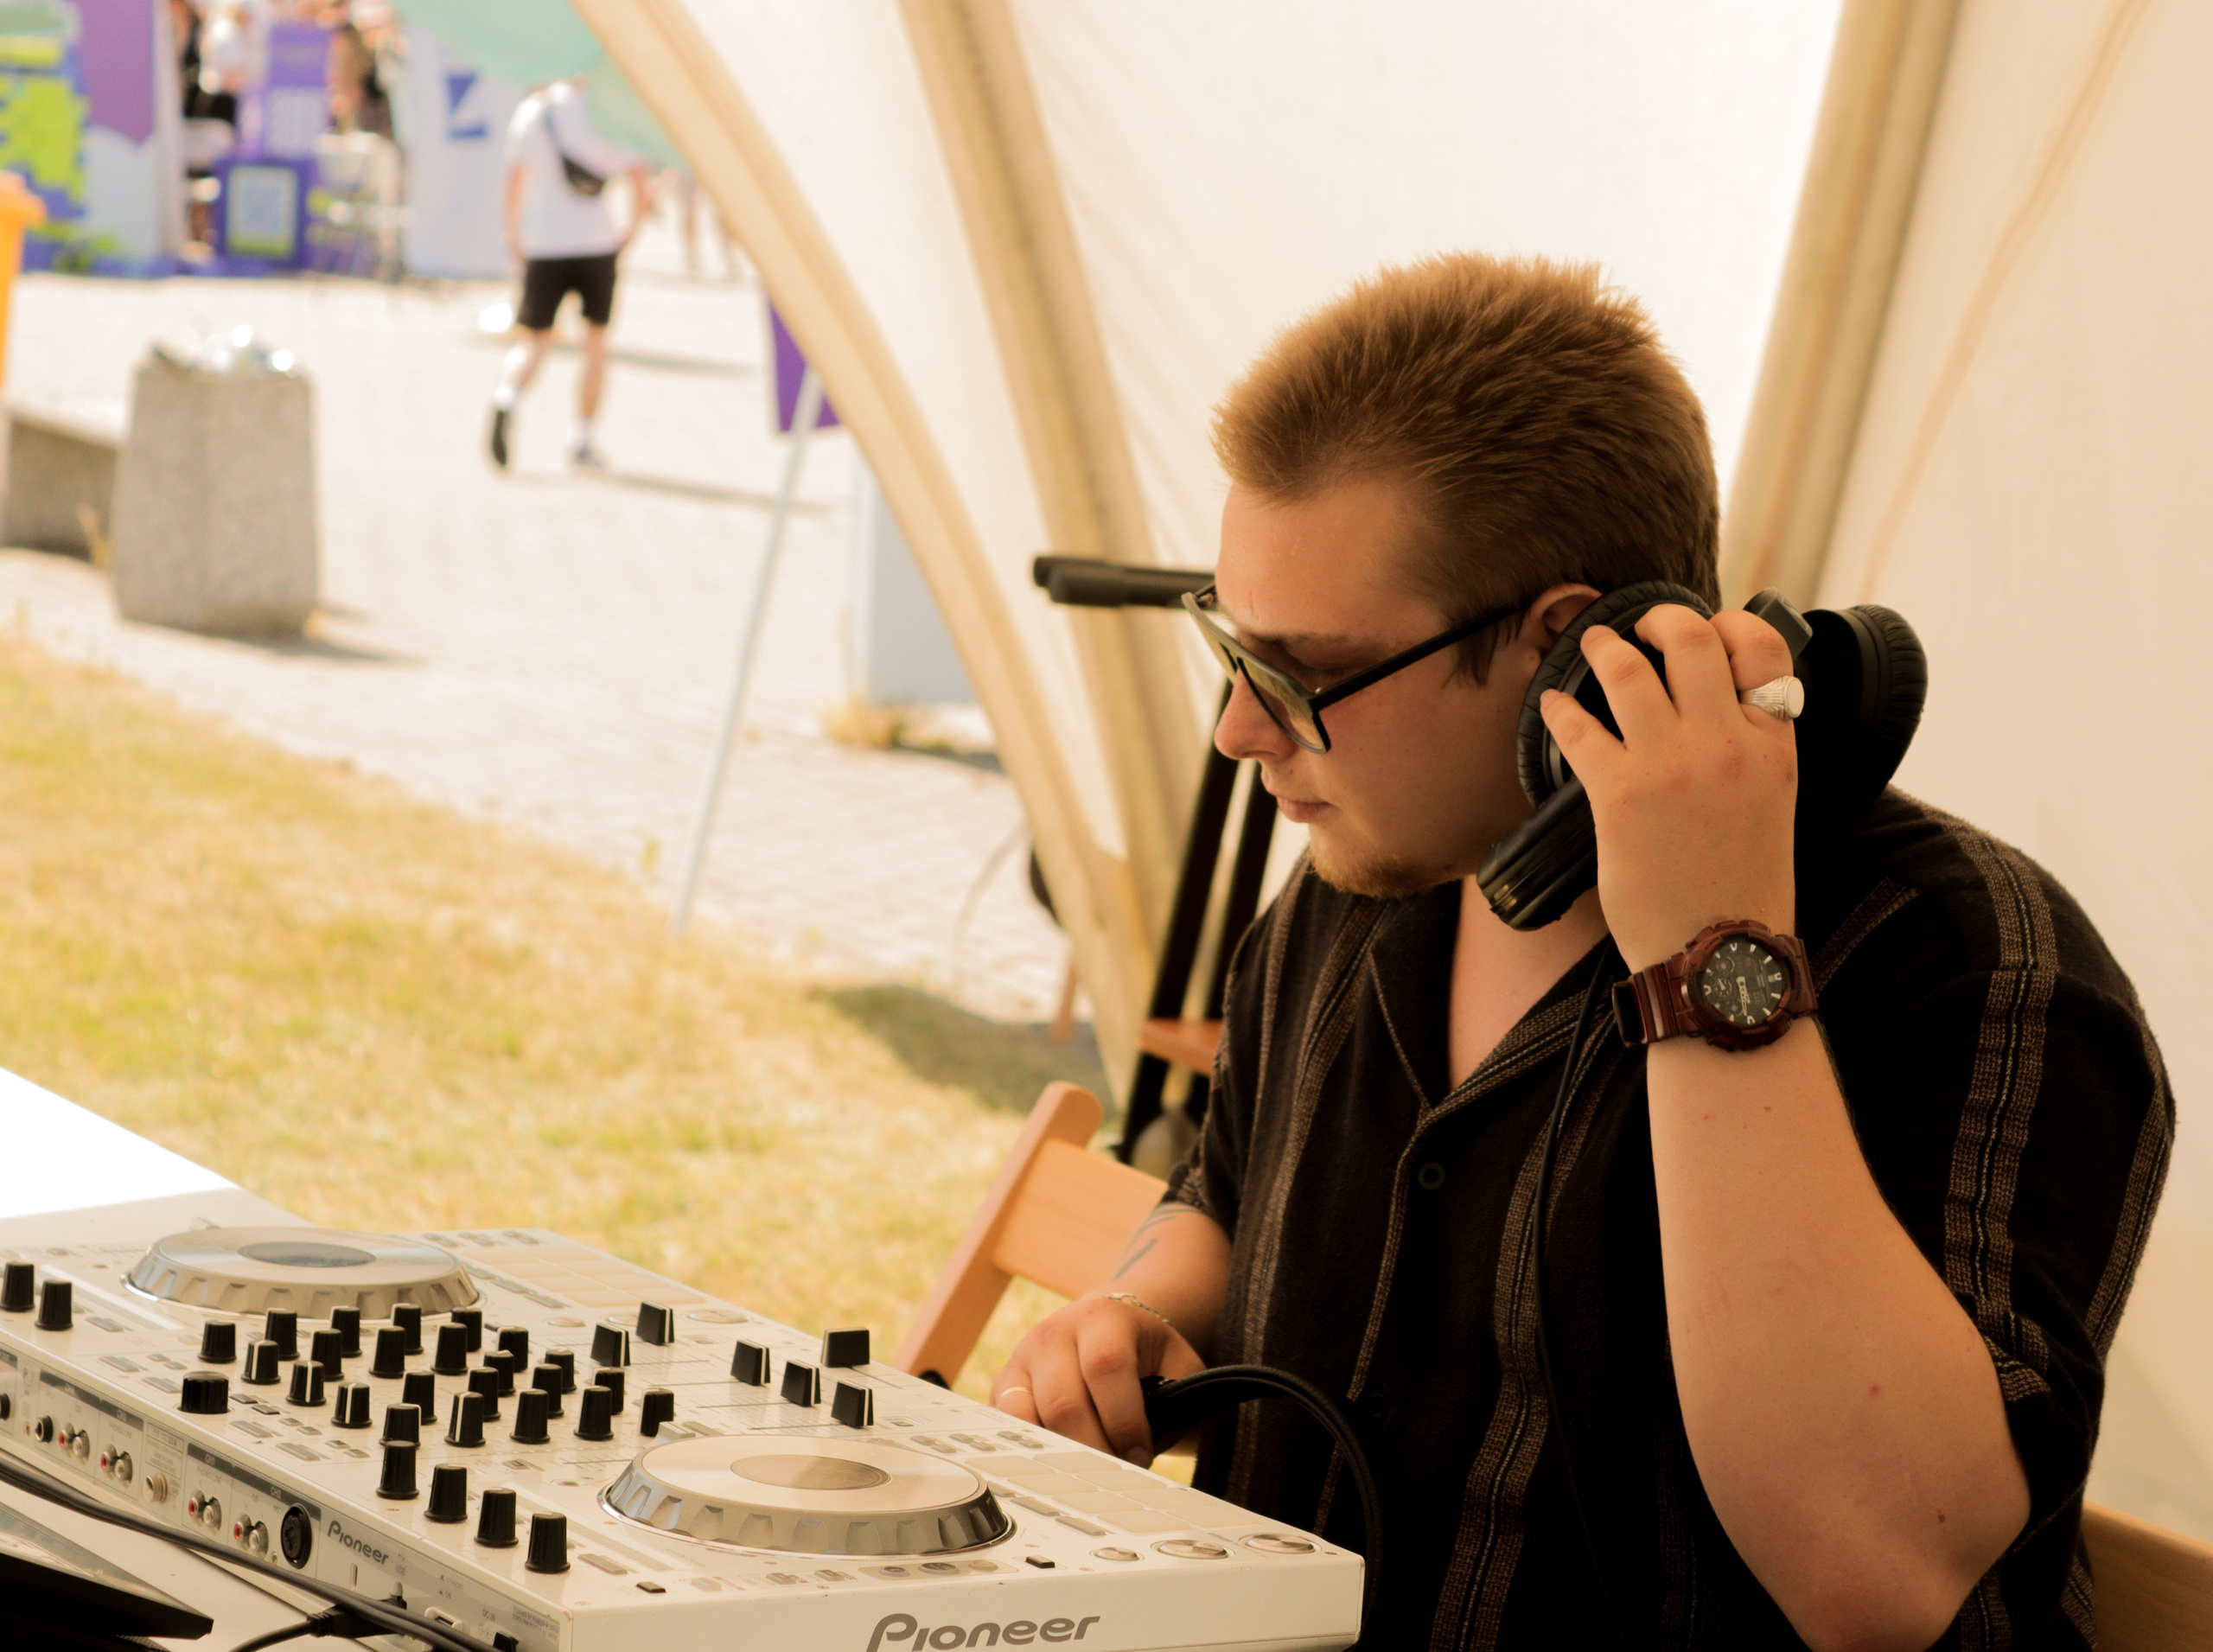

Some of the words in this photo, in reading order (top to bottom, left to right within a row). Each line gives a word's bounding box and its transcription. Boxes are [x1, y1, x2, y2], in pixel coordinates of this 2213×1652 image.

[205, 1453, 215, 1465] CH1
[328, 1520, 389, 1565] Pioneer
[396, 1565, 405, 1576] USB
[866, 1613, 1101, 1652] Pioneer
